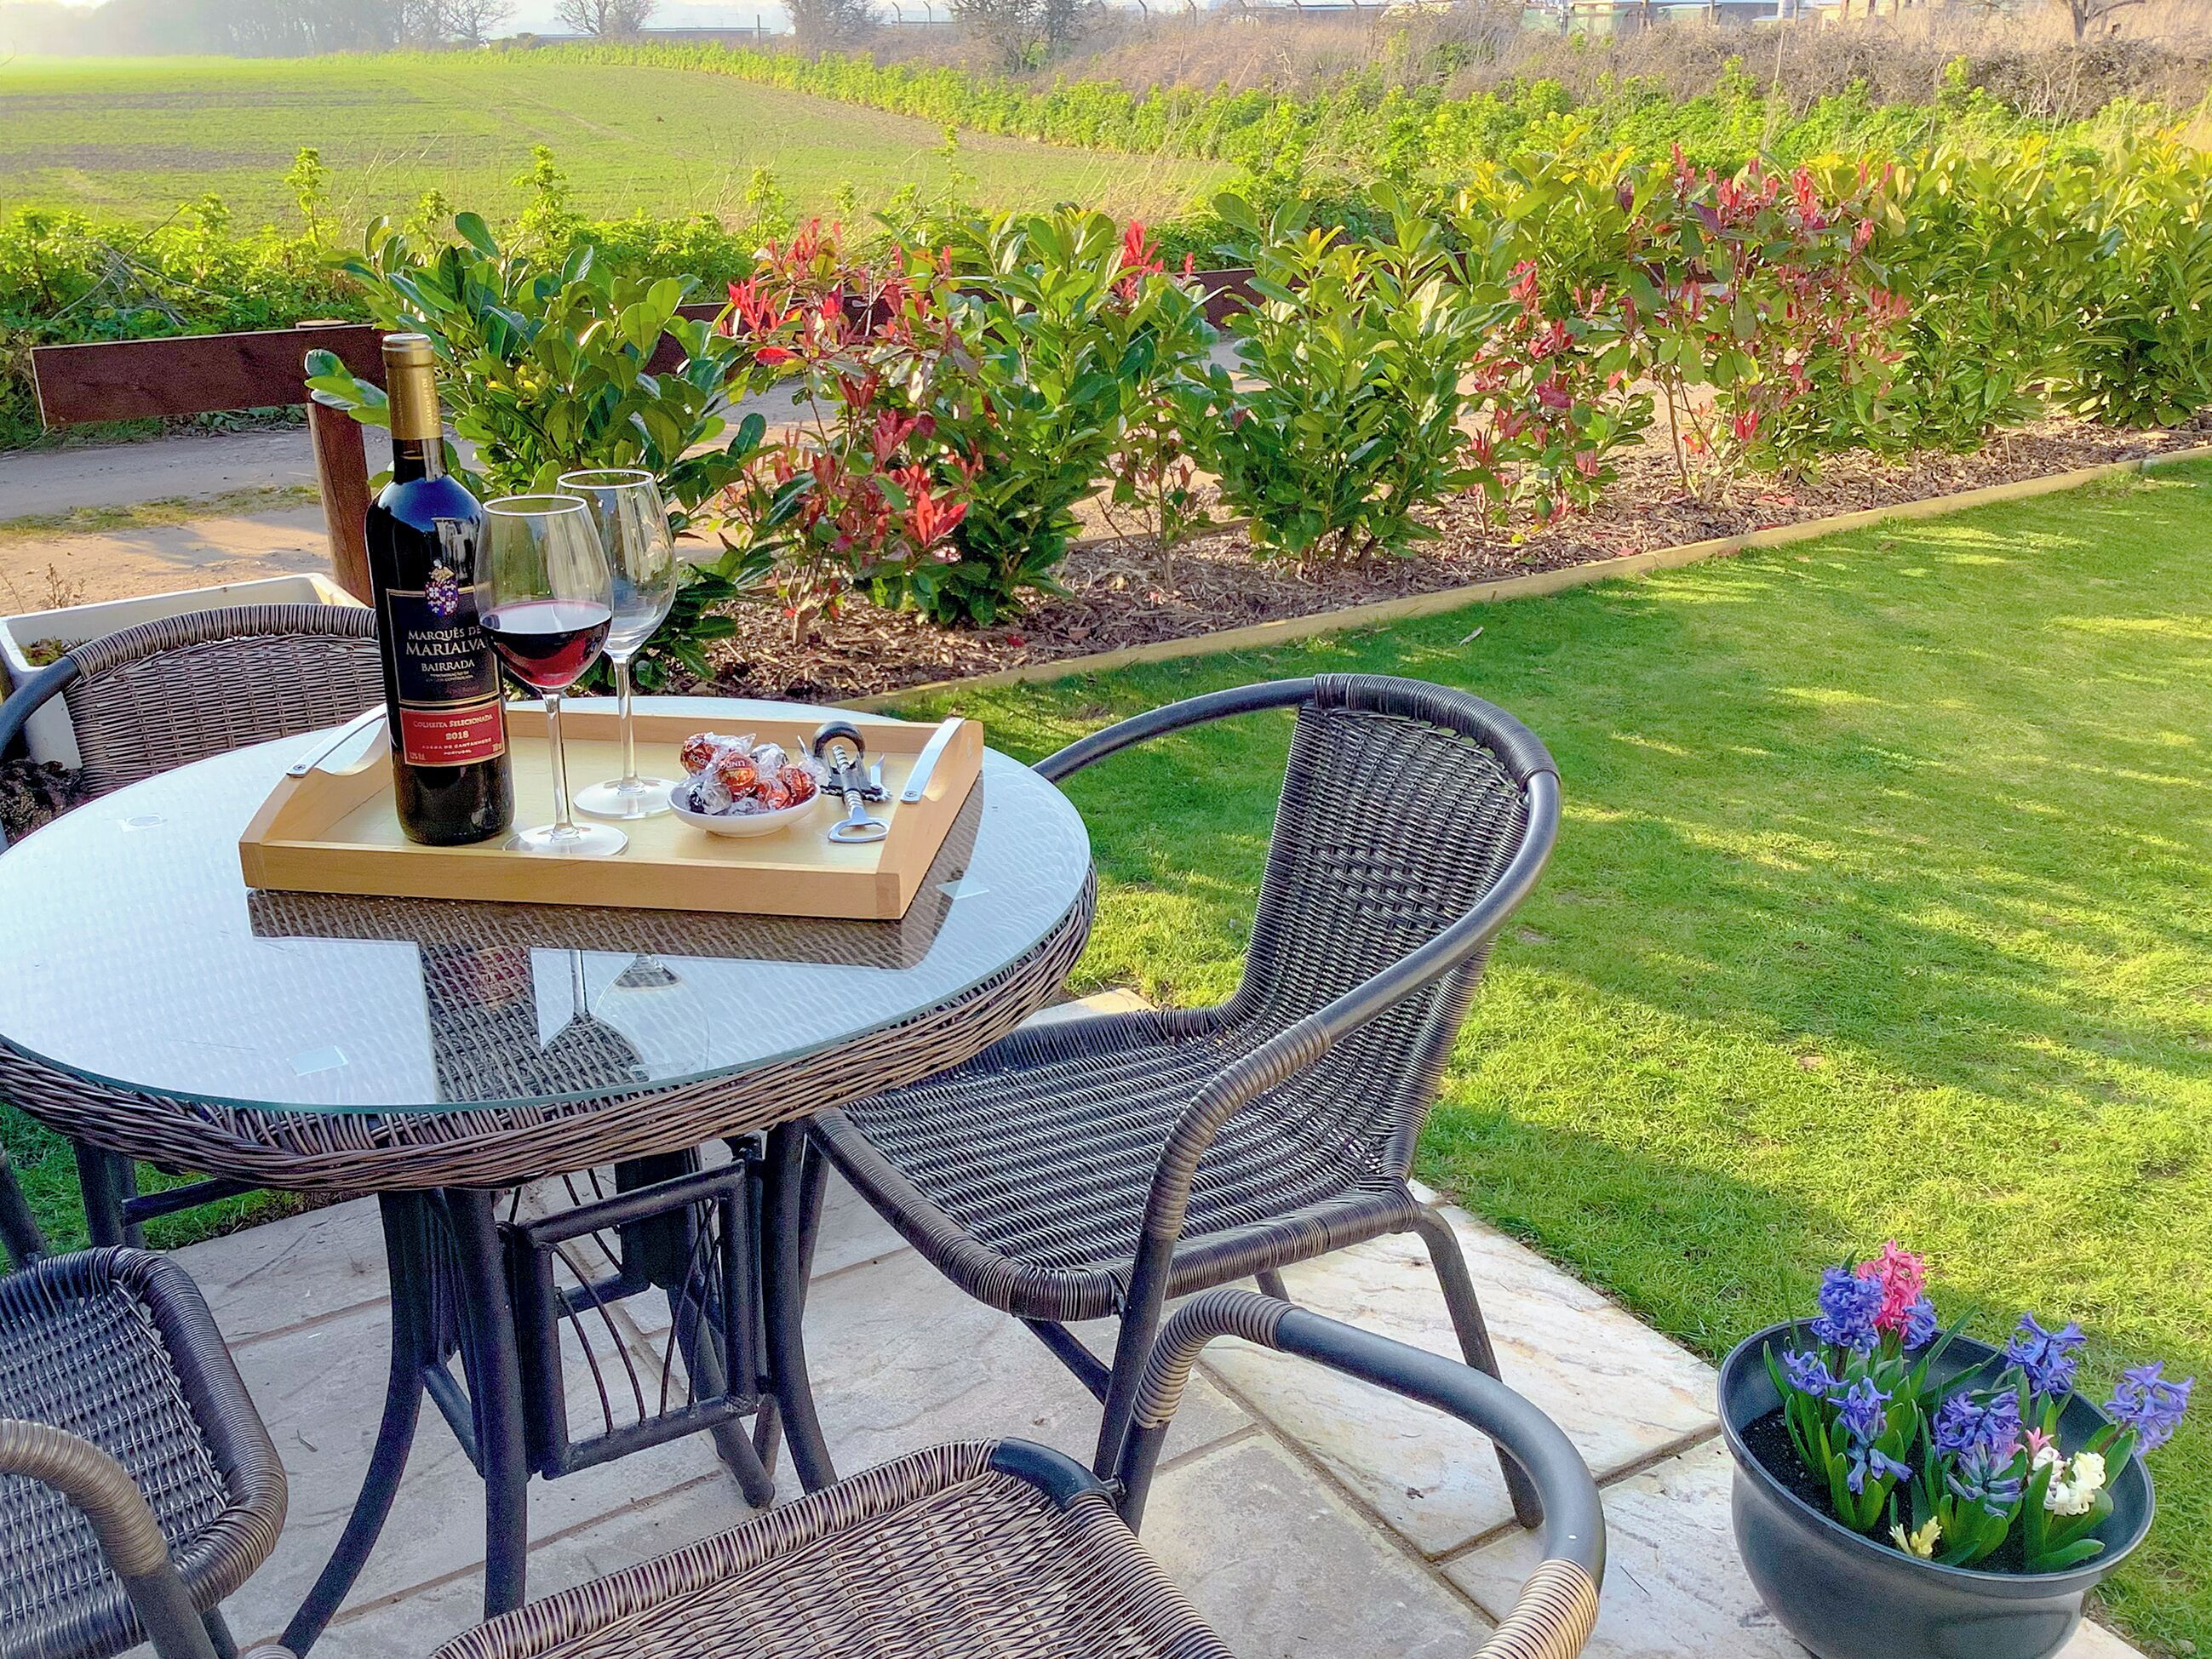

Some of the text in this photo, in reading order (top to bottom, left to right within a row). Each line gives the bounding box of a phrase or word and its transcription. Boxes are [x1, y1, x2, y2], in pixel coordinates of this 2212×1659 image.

[408, 626, 482, 641] MARQUÊS DE
[405, 638, 486, 656] MARIALVA
[421, 659, 475, 672] BAIRRADA
[449, 714, 494, 728] SELECIONADA
[445, 730, 470, 741] 2018
